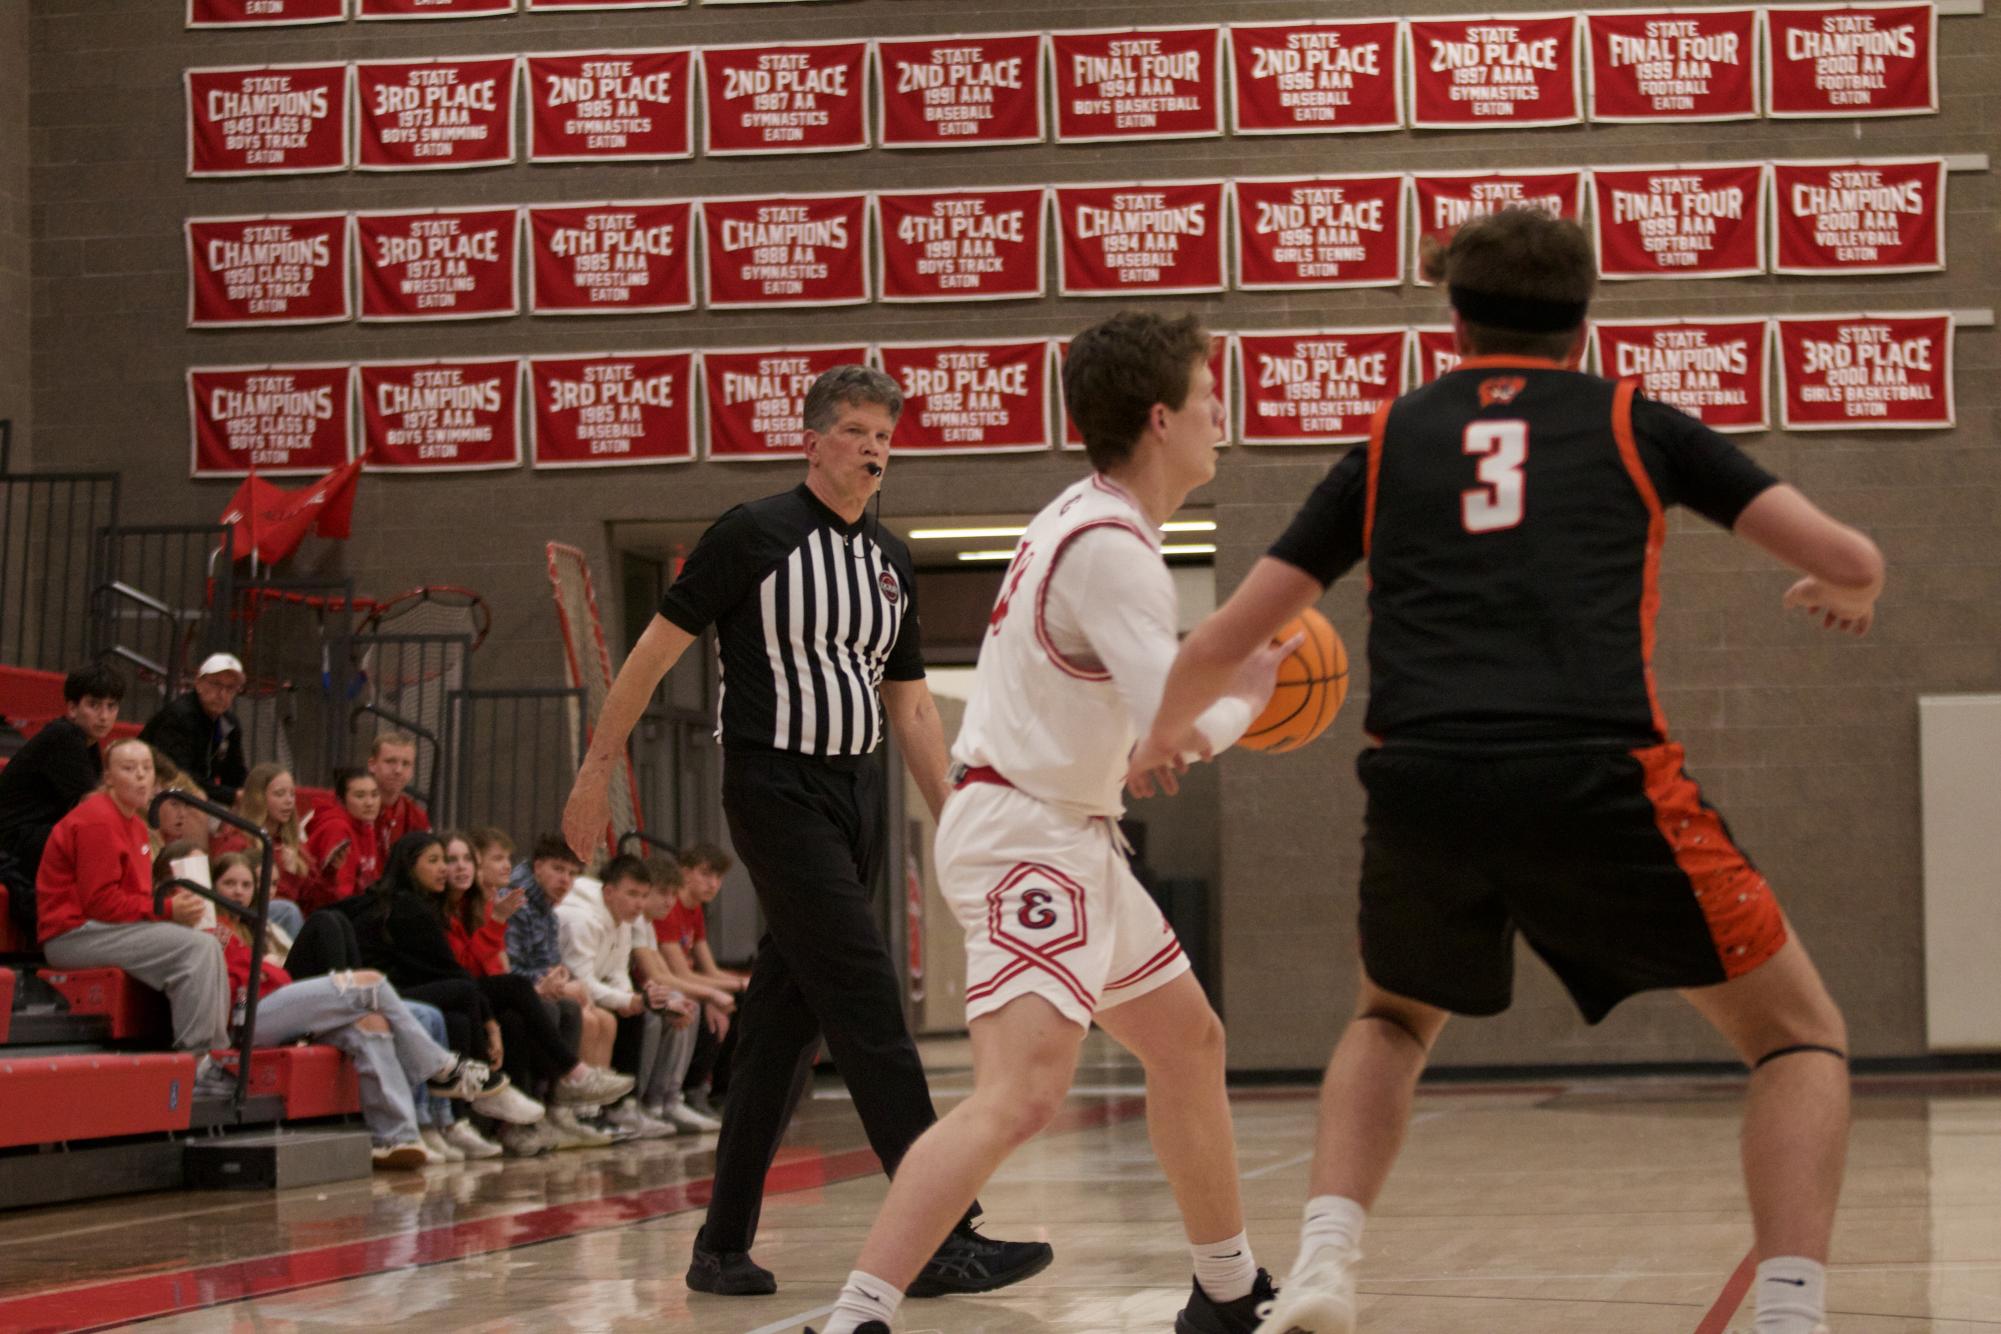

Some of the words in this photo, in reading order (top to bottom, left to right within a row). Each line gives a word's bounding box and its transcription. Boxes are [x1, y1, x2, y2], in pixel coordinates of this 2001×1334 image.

[1825, 16, 1875, 32] STATE
[1468, 27, 1519, 45] STATE
[1787, 25, 1915, 60] CHAMPIONS
[932, 48, 982, 64] STATE
[1110, 40, 1160, 57] STATE
[1431, 39, 1484, 72] 2ND
[1487, 38, 1557, 69] PLACE
[1610, 34, 1674, 66] FINAL
[1679, 32, 1738, 64] FOUR
[1074, 55, 1137, 86] FINAL
[1141, 51, 1199, 82] FOUR
[1252, 47, 1300, 78] 2ND
[1306, 43, 1379, 75] PLACE
[1818, 55, 1857, 75] 2000
[1863, 55, 1884, 73] AA
[580, 62, 632, 79] STATE
[898, 62, 944, 93] 2ND
[950, 58, 1021, 88] PLACE
[1454, 66, 1488, 84] 1997
[1492, 66, 1534, 83] AAAA
[1636, 61, 1672, 81] 1999
[1677, 60, 1711, 78] AAA
[243, 77, 290, 93] STATE
[547, 75, 593, 106] 2ND
[600, 72, 670, 103] PLACE
[724, 68, 770, 99] 2ND
[776, 65, 847, 96] PLACE
[1100, 79, 1135, 97] 1994
[1141, 78, 1174, 95] AAA
[1278, 72, 1314, 90] 1996
[1319, 71, 1352, 89] AAA
[1640, 79, 1709, 95] FOOTBALL
[1817, 74, 1885, 90] FOOTBALL
[374, 84, 419, 115] 3RD
[426, 80, 496, 111] PLACE
[755, 92, 788, 110] 1987
[794, 92, 815, 109] AA
[925, 87, 955, 104] 1991
[960, 86, 992, 103] AAA
[1281, 91, 1350, 106] BASEBALL
[1450, 85, 1538, 100] GYMNASTICS
[1831, 90, 1870, 104] EATON
[208, 87, 327, 121] CHAMPIONS
[617, 100, 638, 116] AA
[1074, 100, 1111, 114] BOYS
[1114, 97, 1200, 113] BASKETBALL
[1473, 102, 1513, 115] EATON
[399, 108, 433, 127] 1973
[438, 108, 469, 125] AAA
[742, 112, 828, 127] GYMNASTICS
[926, 106, 992, 121] BASEBALL
[1117, 114, 1155, 128] EATON
[382, 128, 417, 142] BOYS
[421, 126, 487, 141] SWIMMING
[566, 118, 651, 134] GYMNASTICS
[226, 135, 260, 149] BOYS
[265, 134, 307, 148] TRACK
[588, 135, 626, 148] EATON
[1651, 176, 1704, 195] STATE
[1830, 171, 1883, 188] STATE
[1471, 183, 1524, 200] STATE
[1793, 181, 1922, 216] CHAMPIONS
[935, 200, 984, 217] STATE
[1114, 194, 1165, 210] STATE
[1613, 190, 1678, 224] FINAL
[1682, 187, 1742, 218] FOUR
[586, 214, 635, 231] STATE
[1078, 203, 1204, 238] CHAMPIONS
[1257, 202, 1304, 234] 2ND
[1310, 199, 1382, 231] PLACE
[1816, 211, 1859, 232] 2000
[1864, 210, 1898, 230] AAA
[244, 226, 291, 243] STATE
[722, 216, 847, 251] CHAMPIONS
[899, 216, 944, 244] 4TH
[951, 211, 1023, 242] PLACE
[1640, 216, 1676, 237] 1999
[1682, 215, 1715, 235] AAA
[551, 229, 595, 256] 4TH
[603, 225, 672, 256] PLACE
[1104, 234, 1139, 252] 1994
[1144, 233, 1177, 251] AAA
[1280, 228, 1313, 246] 1996
[1317, 227, 1358, 244] AAAA
[1644, 235, 1712, 252] SOFTBALL
[1815, 230, 1901, 247] VOLLEYBALL
[209, 234, 329, 271] CHAMPIONS
[378, 236, 422, 267] 3RD
[428, 230, 498, 261] PLACE
[926, 240, 956, 258] 1991
[962, 240, 994, 257] AAA
[1274, 247, 1313, 262] GIRLS
[1318, 246, 1365, 261] TENNIS
[1837, 246, 1877, 260] EATON
[407, 259, 441, 278] 1973
[446, 259, 467, 276] AA
[918, 259, 954, 274] BOYS
[958, 258, 1002, 272] TRACK
[1106, 252, 1174, 267] BASEBALL
[575, 272, 648, 286] WRESTLING
[742, 264, 827, 279] GYMNASTICS
[229, 284, 262, 299] BOYS
[267, 281, 309, 298] TRACK
[401, 276, 474, 293] WRESTLING
[940, 274, 979, 288] EATON
[1839, 326, 1889, 344] STATE
[1296, 342, 1346, 360] STATE
[1617, 341, 1746, 376] CHAMPIONS
[1803, 340, 1851, 373] 3RD
[1857, 338, 1931, 370] PLACE
[585, 365, 634, 383] STATE
[759, 358, 809, 375] STATE
[1260, 352, 1307, 387] 2ND
[1311, 353, 1386, 384] PLACE
[1827, 366, 1868, 386] 2000
[1873, 365, 1907, 385] AAA
[247, 376, 294, 394] STATE
[723, 372, 787, 406] FINAL
[902, 366, 948, 398] 3RD
[955, 364, 1027, 394] PLACE
[1644, 371, 1680, 391] 1999
[1686, 370, 1721, 390] AAA
[378, 379, 500, 415] CHAMPIONS
[550, 379, 595, 412] 3RD
[602, 375, 672, 407] PLACE
[1285, 381, 1321, 400] 1996
[1327, 380, 1359, 398] AAA
[1802, 386, 1841, 401] GIRLS
[1845, 384, 1932, 402] BASKETBALL
[212, 386, 332, 420] CHAMPIONS
[928, 392, 962, 411] 1992
[968, 392, 1000, 410] AAA
[1259, 401, 1296, 416] BOYS
[1846, 401, 1886, 416] EATON
[404, 410, 437, 429] 1972
[443, 408, 474, 427] AAA
[922, 410, 1008, 426] GYMNASTICS
[1302, 416, 1341, 431] EATON
[387, 429, 422, 444] BOYS
[426, 427, 491, 443] SWIMMING
[578, 423, 644, 439] BASEBALL
[230, 434, 264, 449] BOYS
[269, 432, 312, 449] TRACK
[1461, 419, 1529, 535] 3
